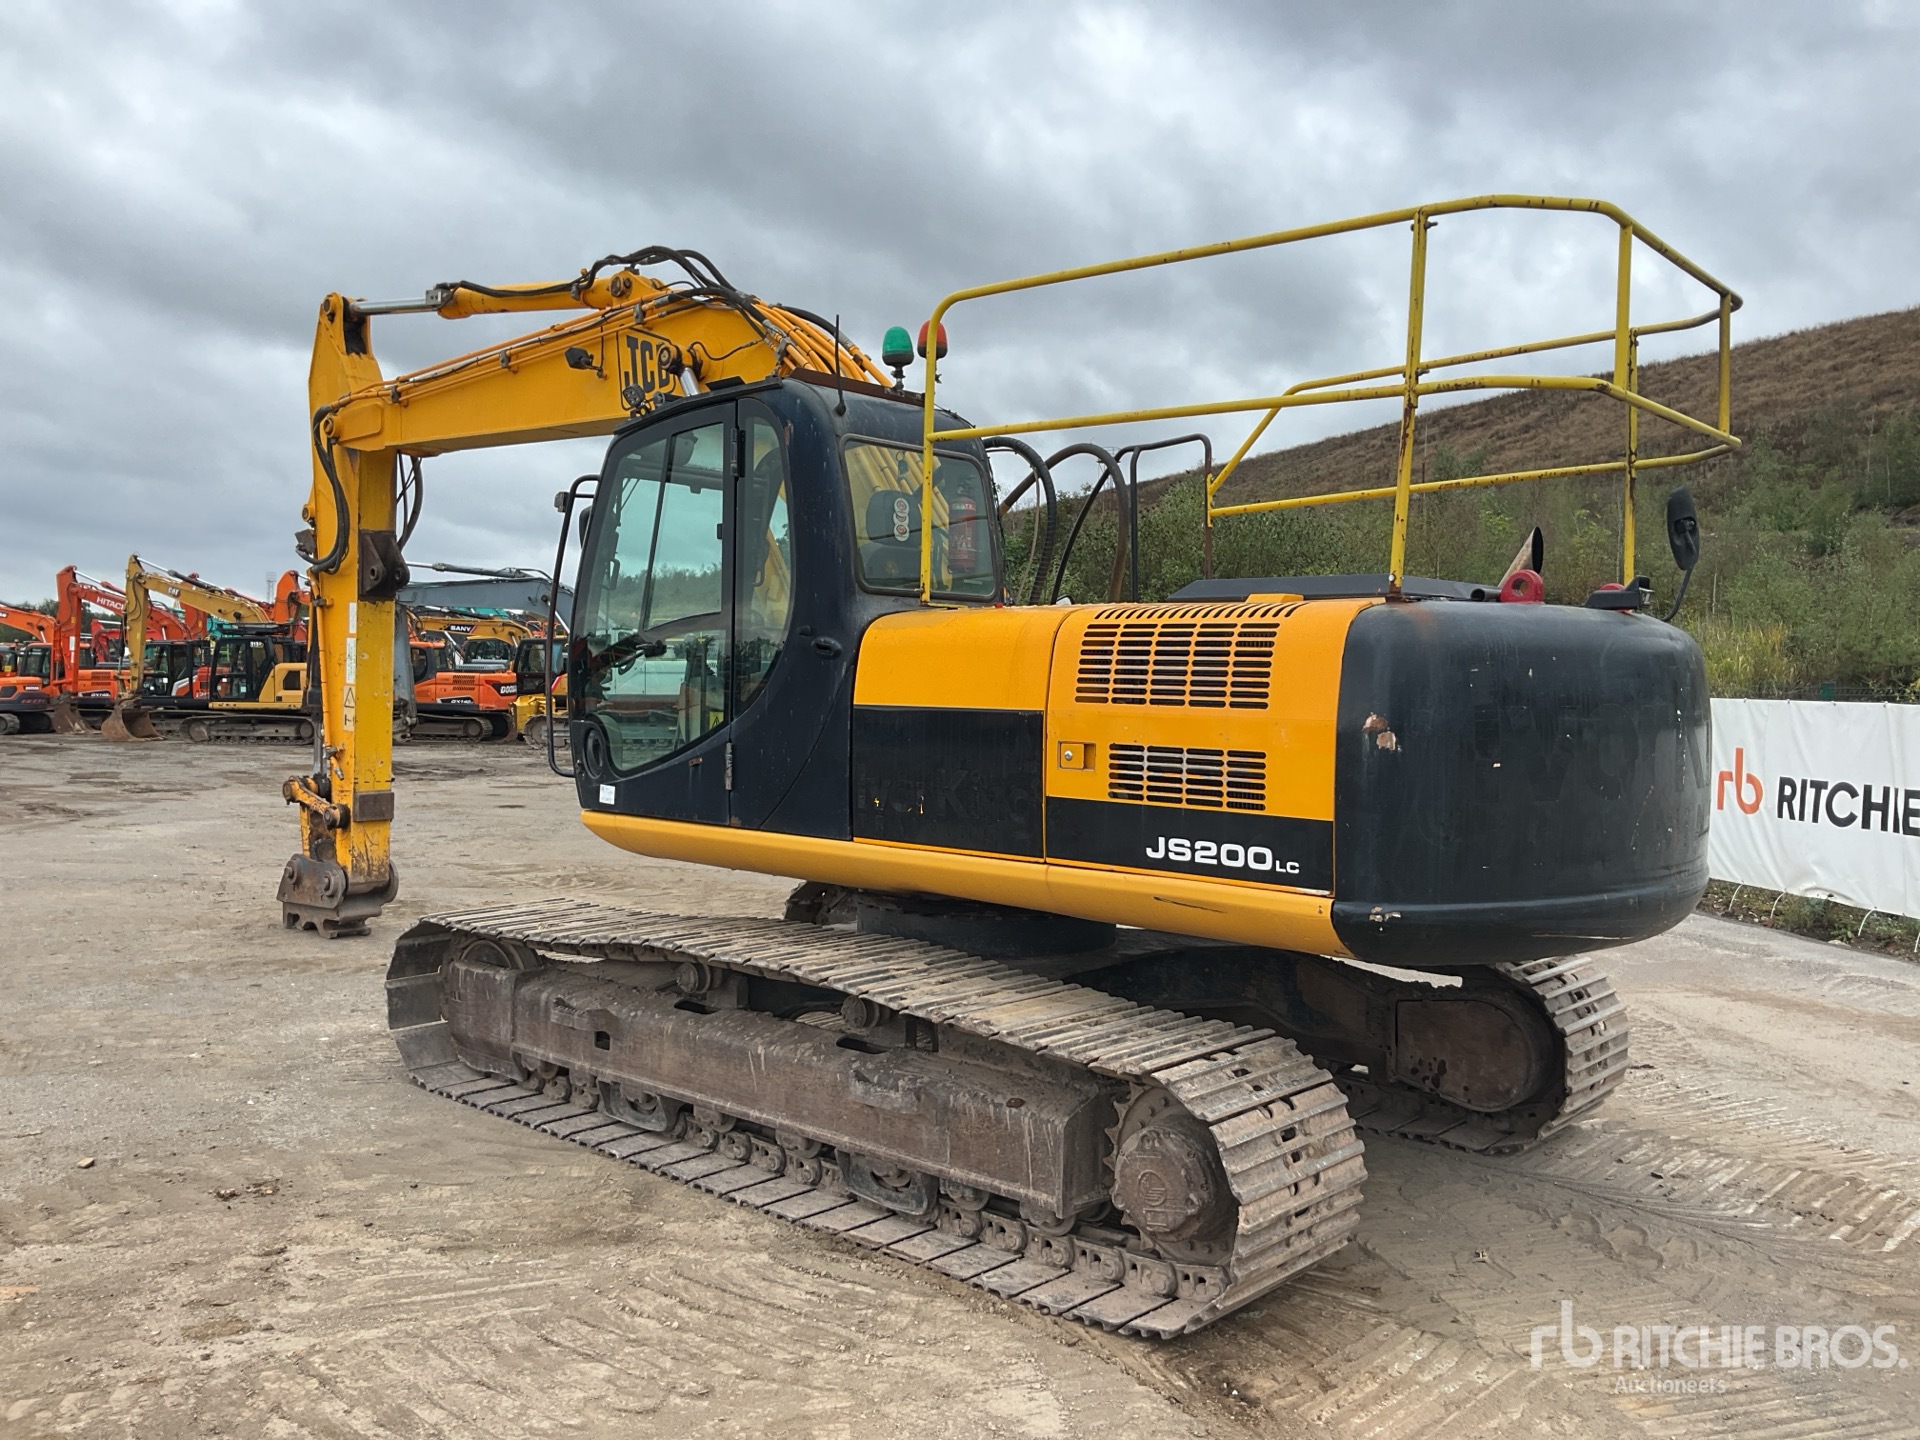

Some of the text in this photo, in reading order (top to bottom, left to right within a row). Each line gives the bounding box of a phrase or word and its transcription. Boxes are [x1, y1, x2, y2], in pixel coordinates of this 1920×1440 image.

[623, 334, 670, 393] JCB
[450, 625, 472, 633] SANY
[1776, 776, 1920, 837] RITCHIE
